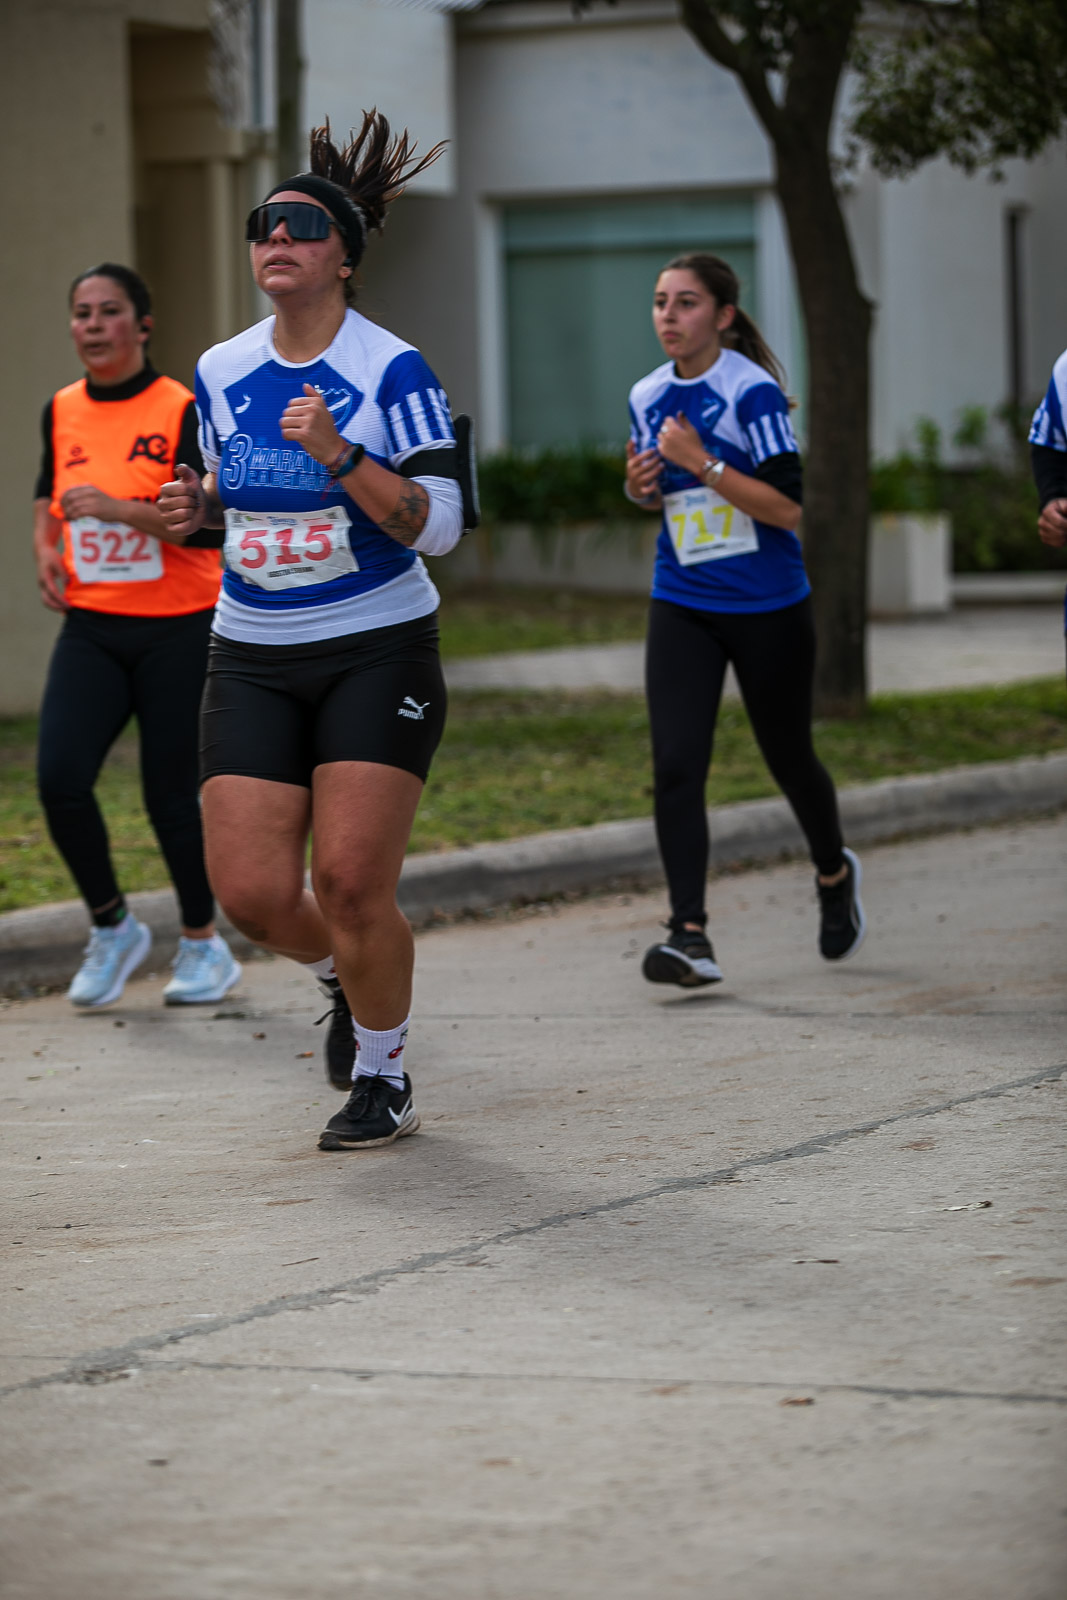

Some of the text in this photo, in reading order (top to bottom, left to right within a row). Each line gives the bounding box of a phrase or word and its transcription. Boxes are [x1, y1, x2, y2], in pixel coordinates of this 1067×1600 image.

[222, 433, 254, 490] 3
[248, 447, 336, 476] MARAT
[80, 529, 152, 565] 522
[239, 524, 334, 569] 515
[671, 504, 734, 549] 717
